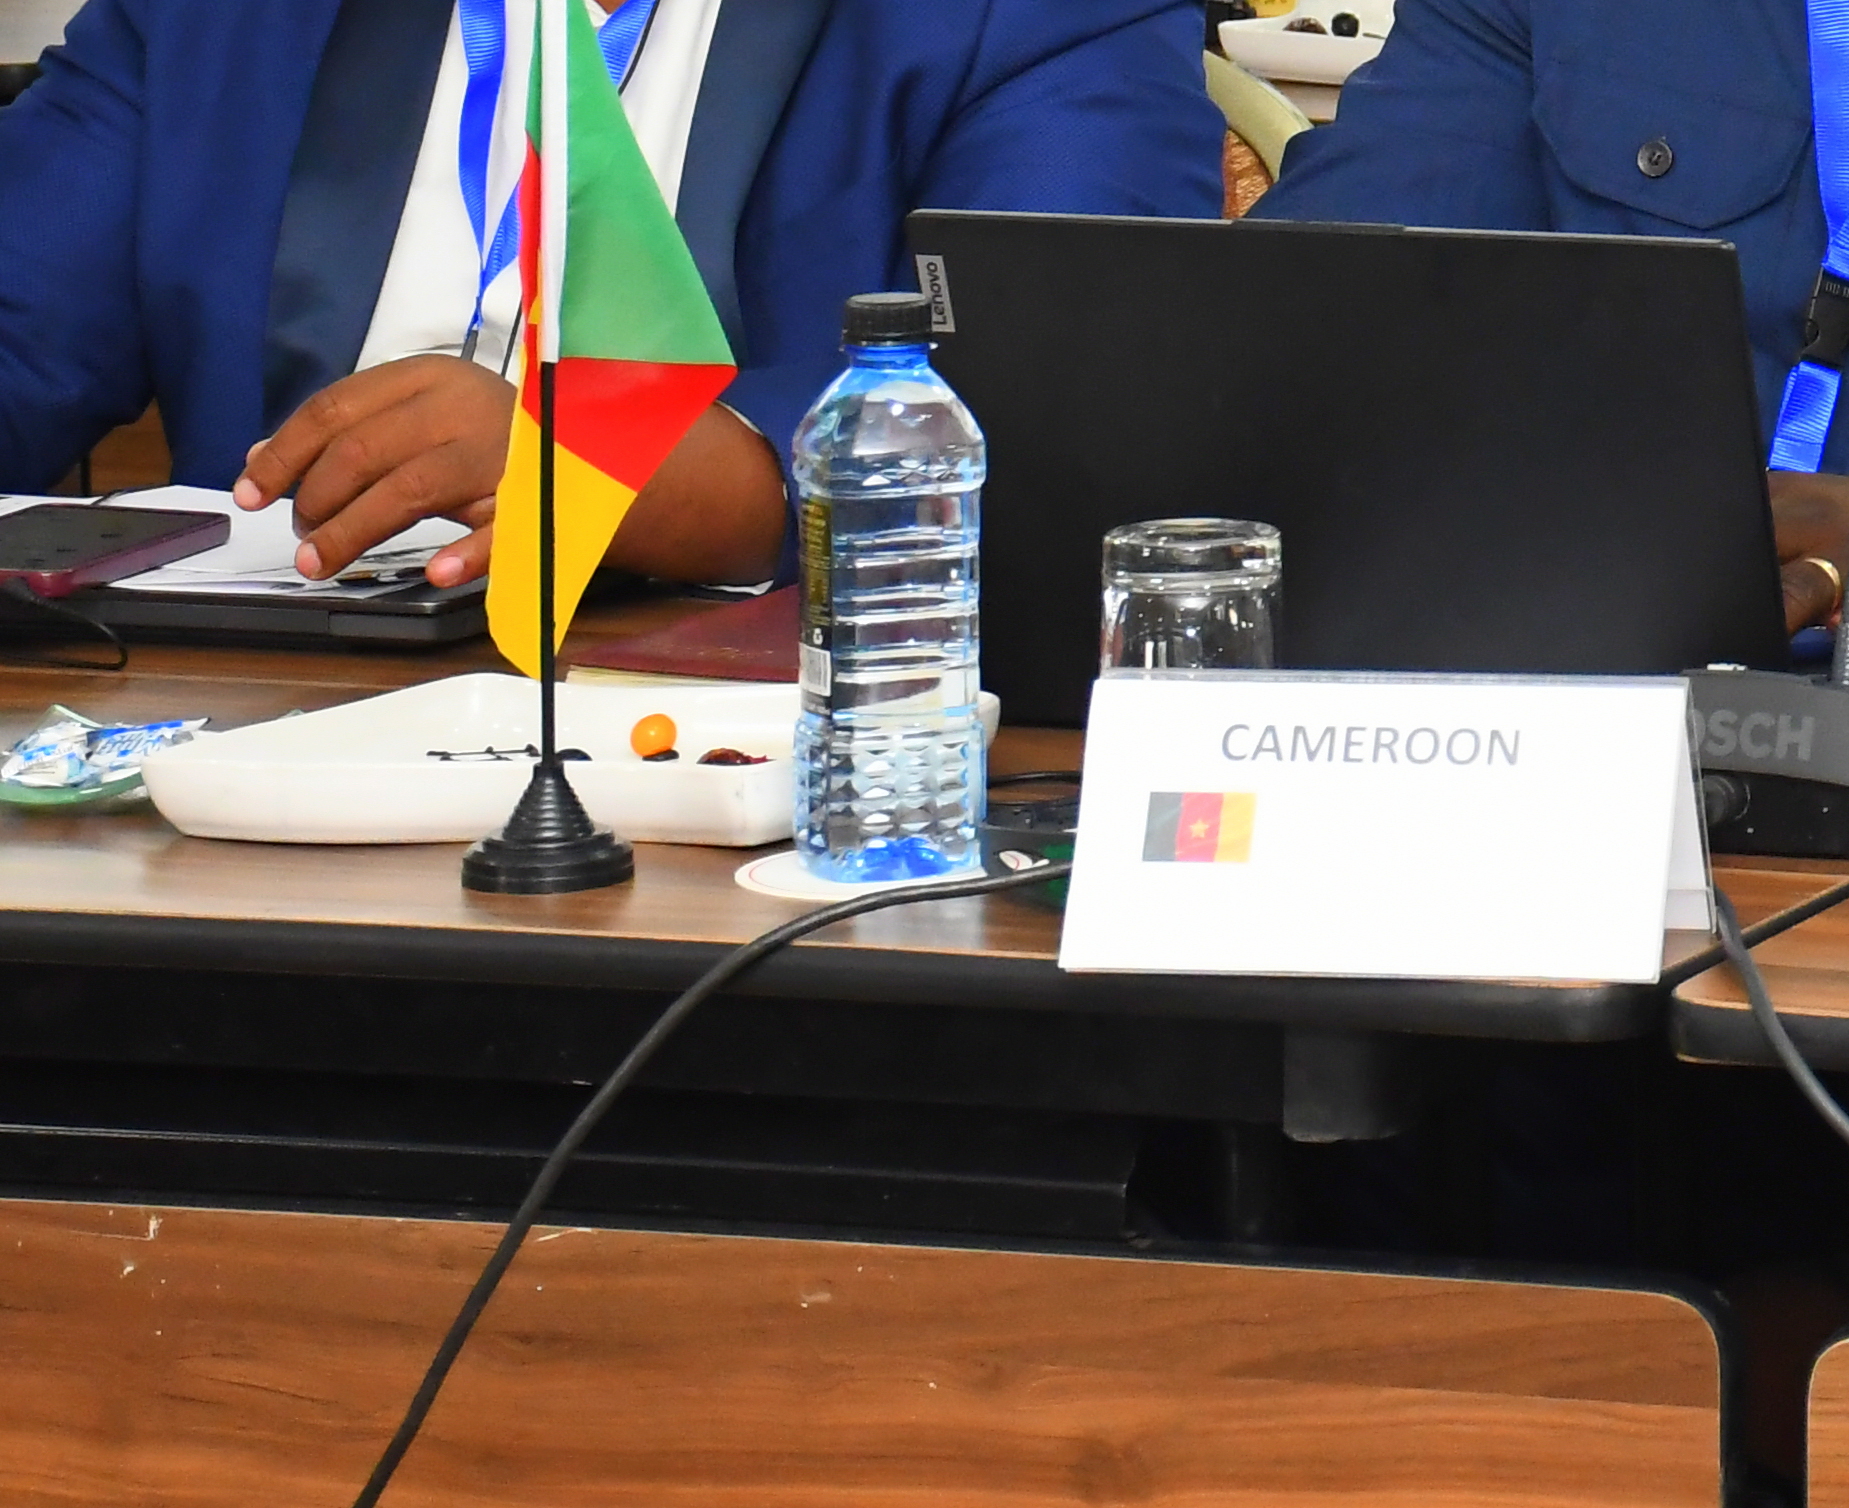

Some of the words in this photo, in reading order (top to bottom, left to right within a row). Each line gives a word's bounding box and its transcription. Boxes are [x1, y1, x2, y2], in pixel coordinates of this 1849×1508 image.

[926, 261, 949, 326] Lenovo
[1220, 722, 1521, 766] CAMEROON
[1690, 709, 1816, 761] SCH
